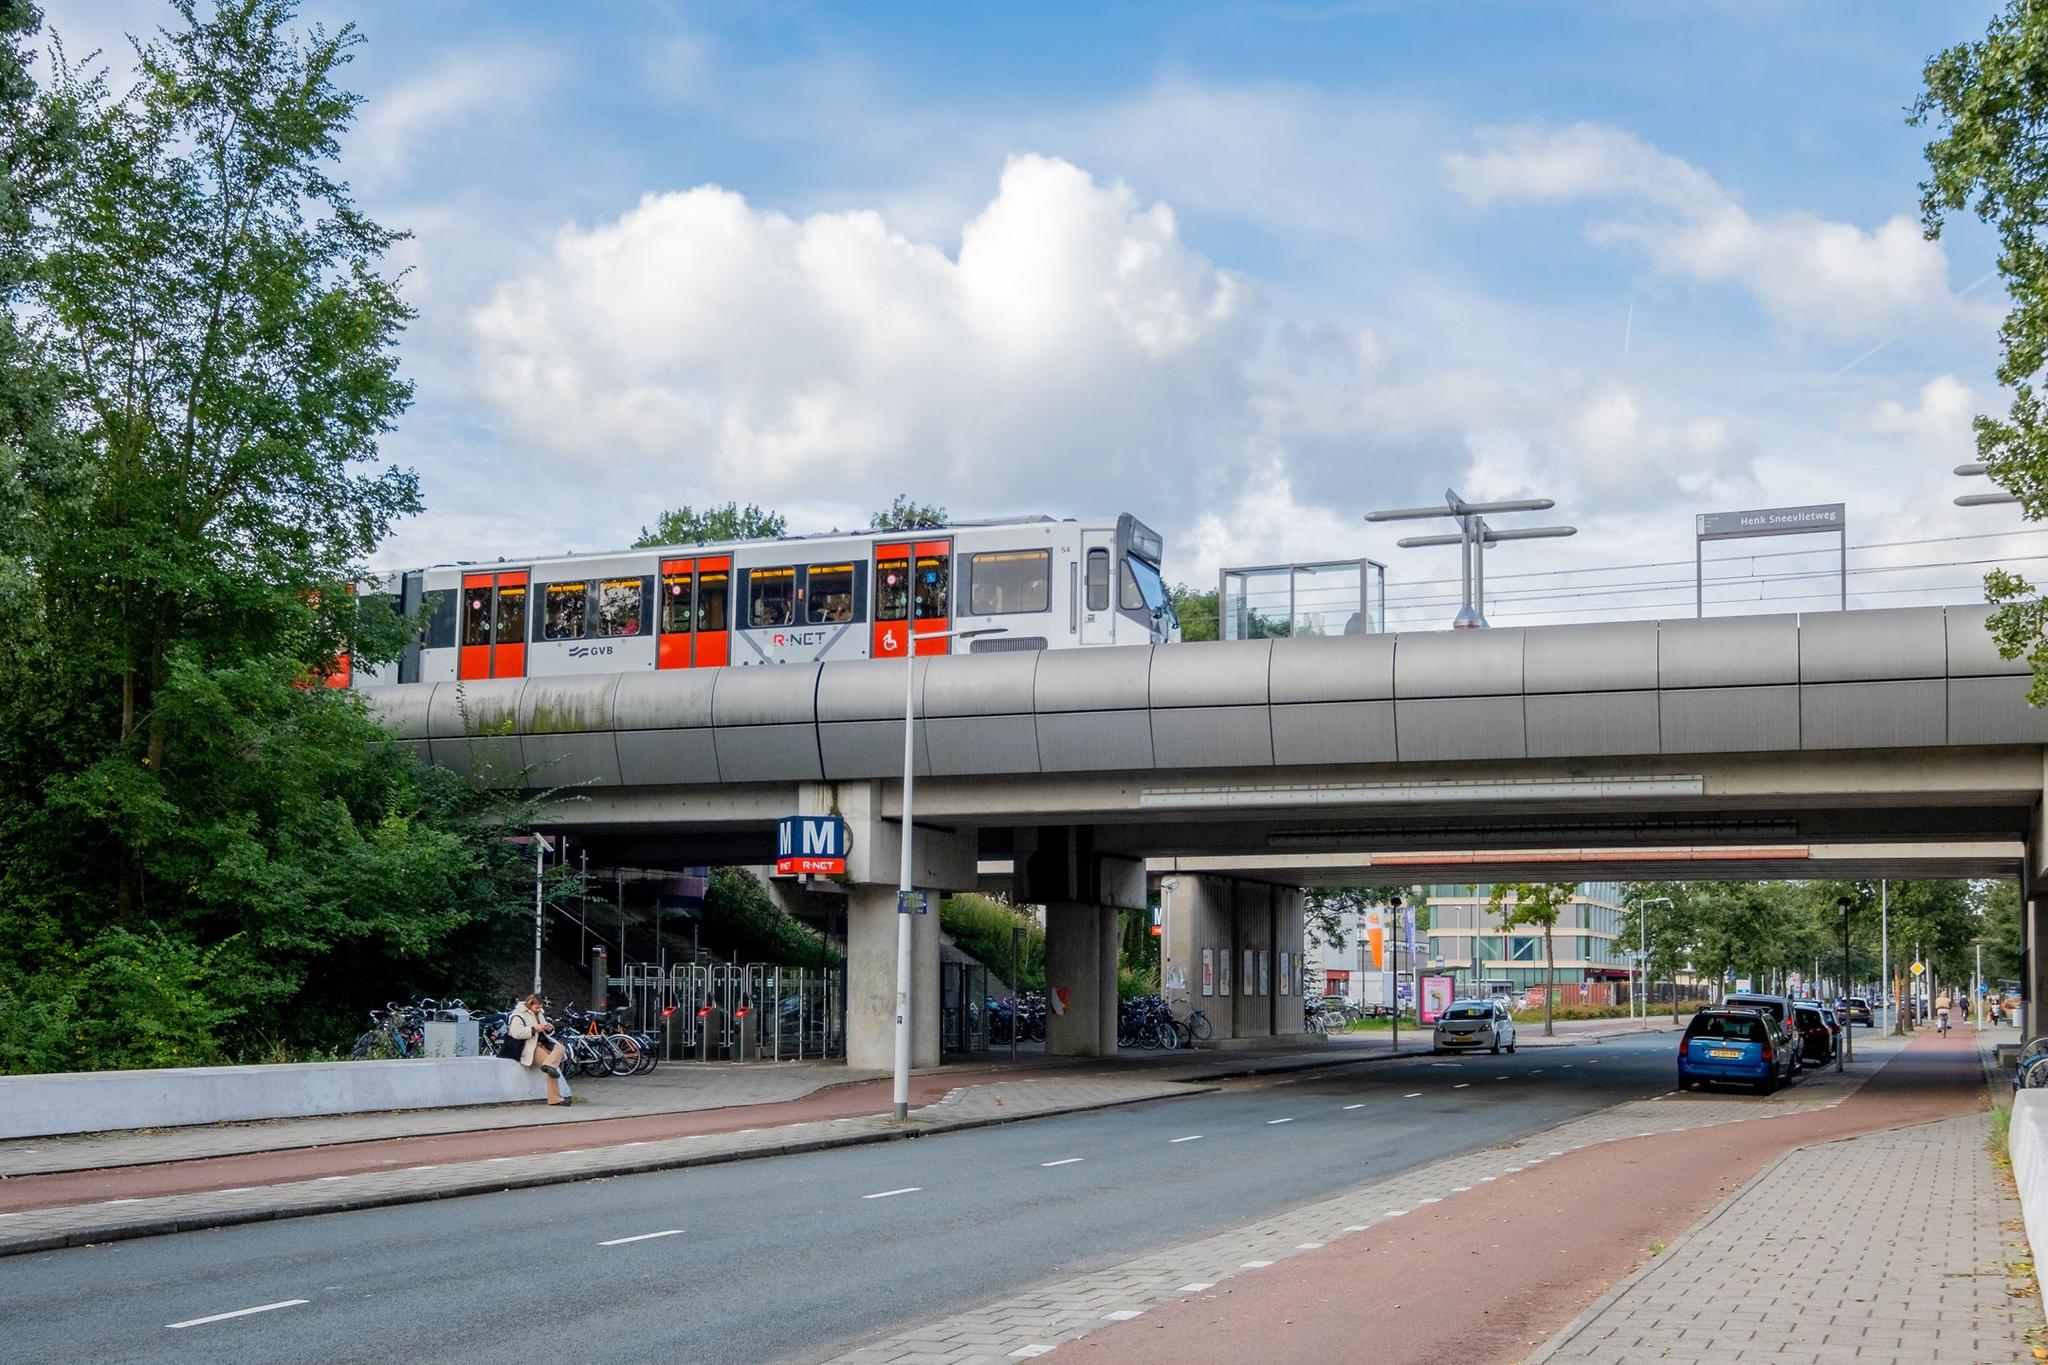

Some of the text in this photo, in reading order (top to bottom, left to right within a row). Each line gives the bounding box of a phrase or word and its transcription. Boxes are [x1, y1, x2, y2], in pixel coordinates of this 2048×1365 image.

[1741, 511, 1837, 525] Henk Sneevlietweg
[591, 646, 613, 656] GVB
[780, 821, 791, 855] M
[802, 820, 834, 854] M
[1154, 908, 1162, 925] M
